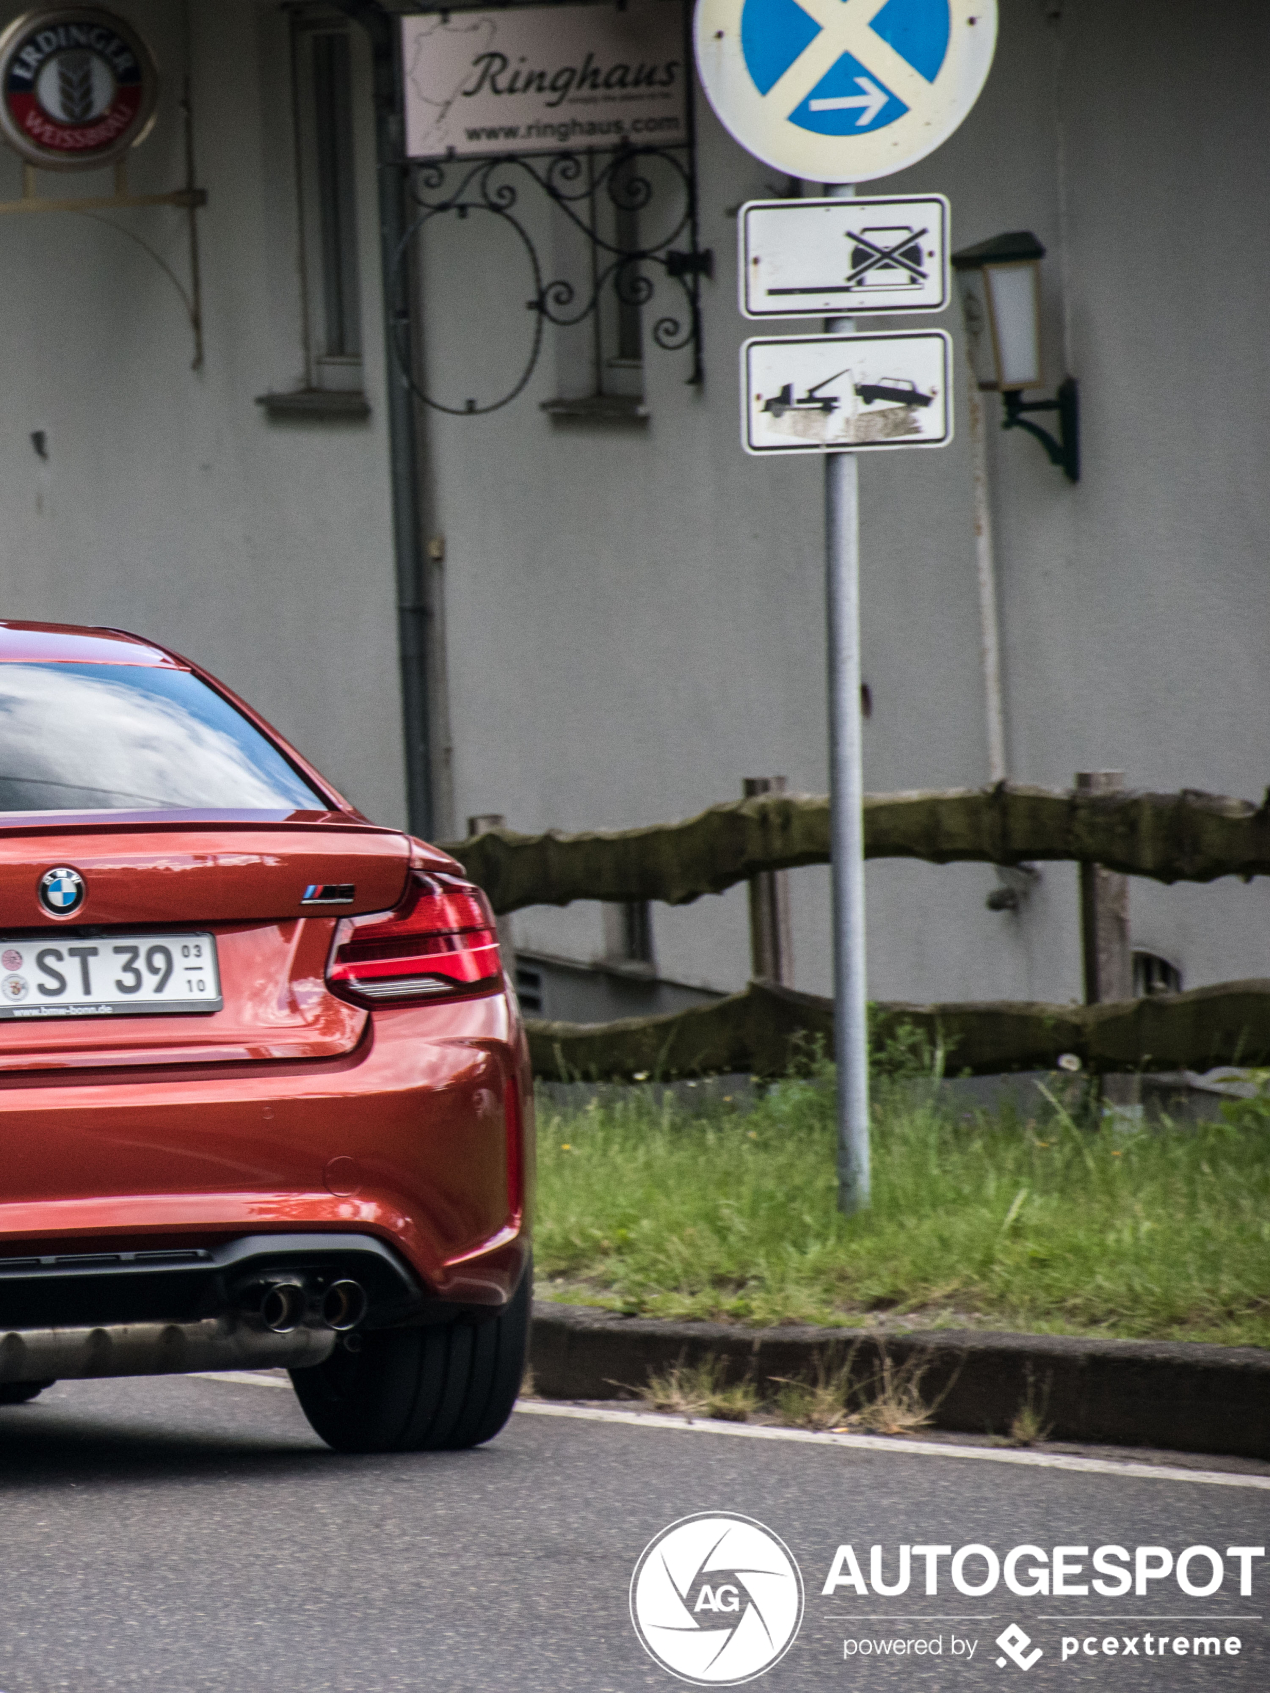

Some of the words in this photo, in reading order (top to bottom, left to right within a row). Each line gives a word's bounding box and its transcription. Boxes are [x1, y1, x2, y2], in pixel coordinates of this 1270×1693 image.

[12, 26, 135, 79] ERDINGER
[462, 52, 679, 107] Ringhaus
[464, 117, 680, 141] www.ringhaus.com
[181, 944, 203, 958] 03
[36, 947, 100, 997] ST
[112, 945, 174, 994] 39
[186, 979, 206, 992] 10
